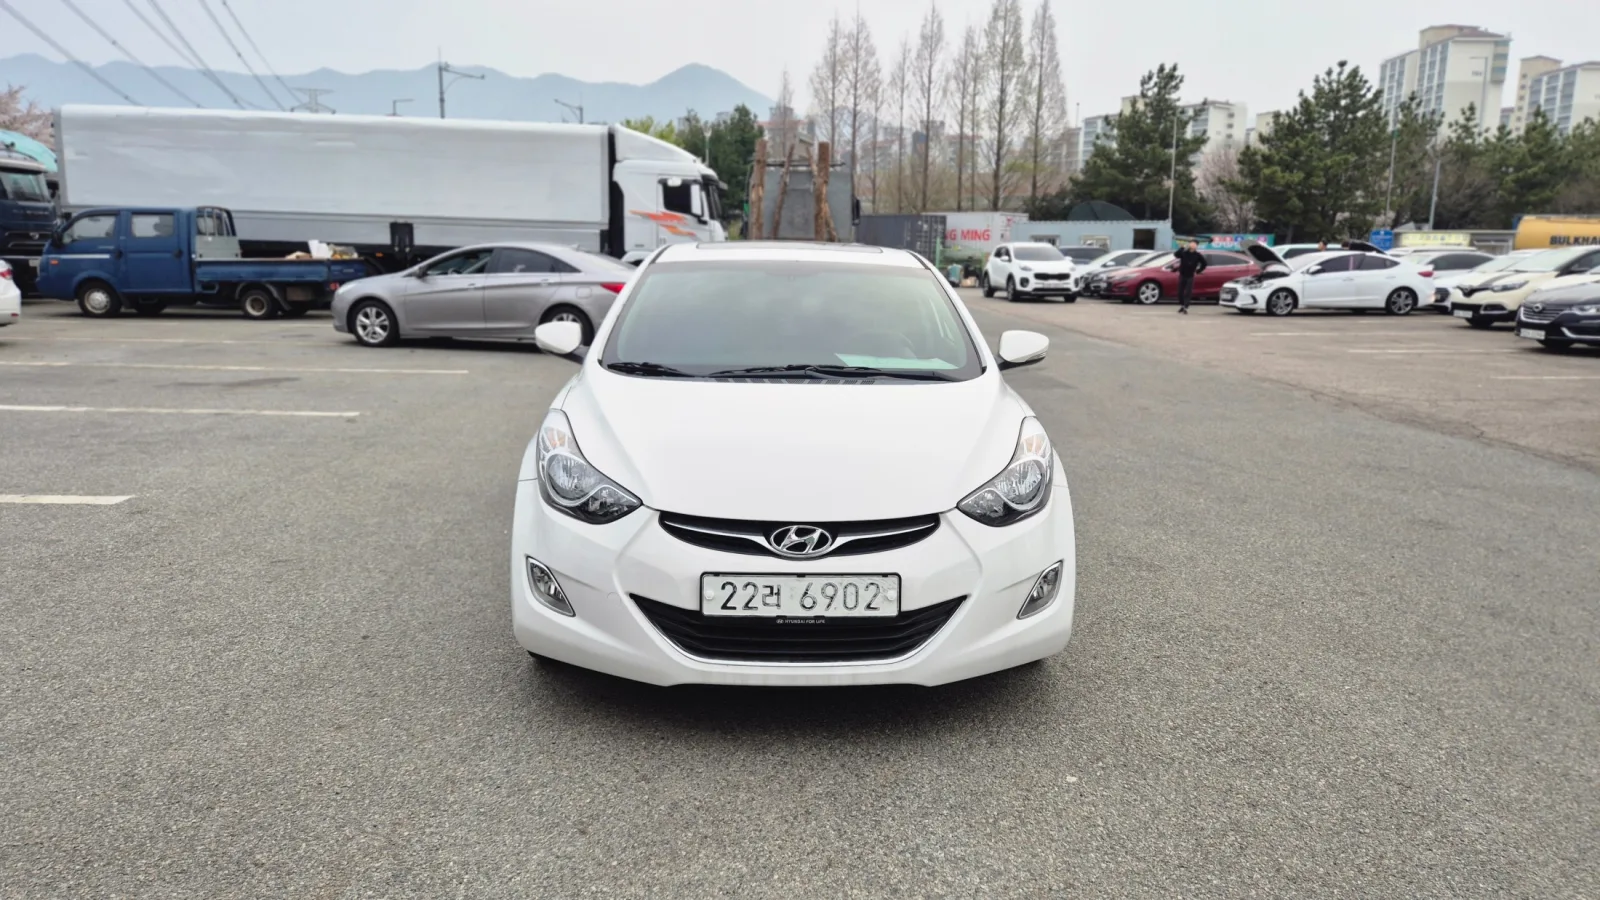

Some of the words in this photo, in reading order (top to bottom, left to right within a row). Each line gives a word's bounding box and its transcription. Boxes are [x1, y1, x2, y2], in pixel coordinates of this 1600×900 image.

[961, 228, 991, 241] MING
[1549, 235, 1600, 246] BULKHA
[720, 581, 781, 611] 22러
[799, 581, 881, 611] 6902
